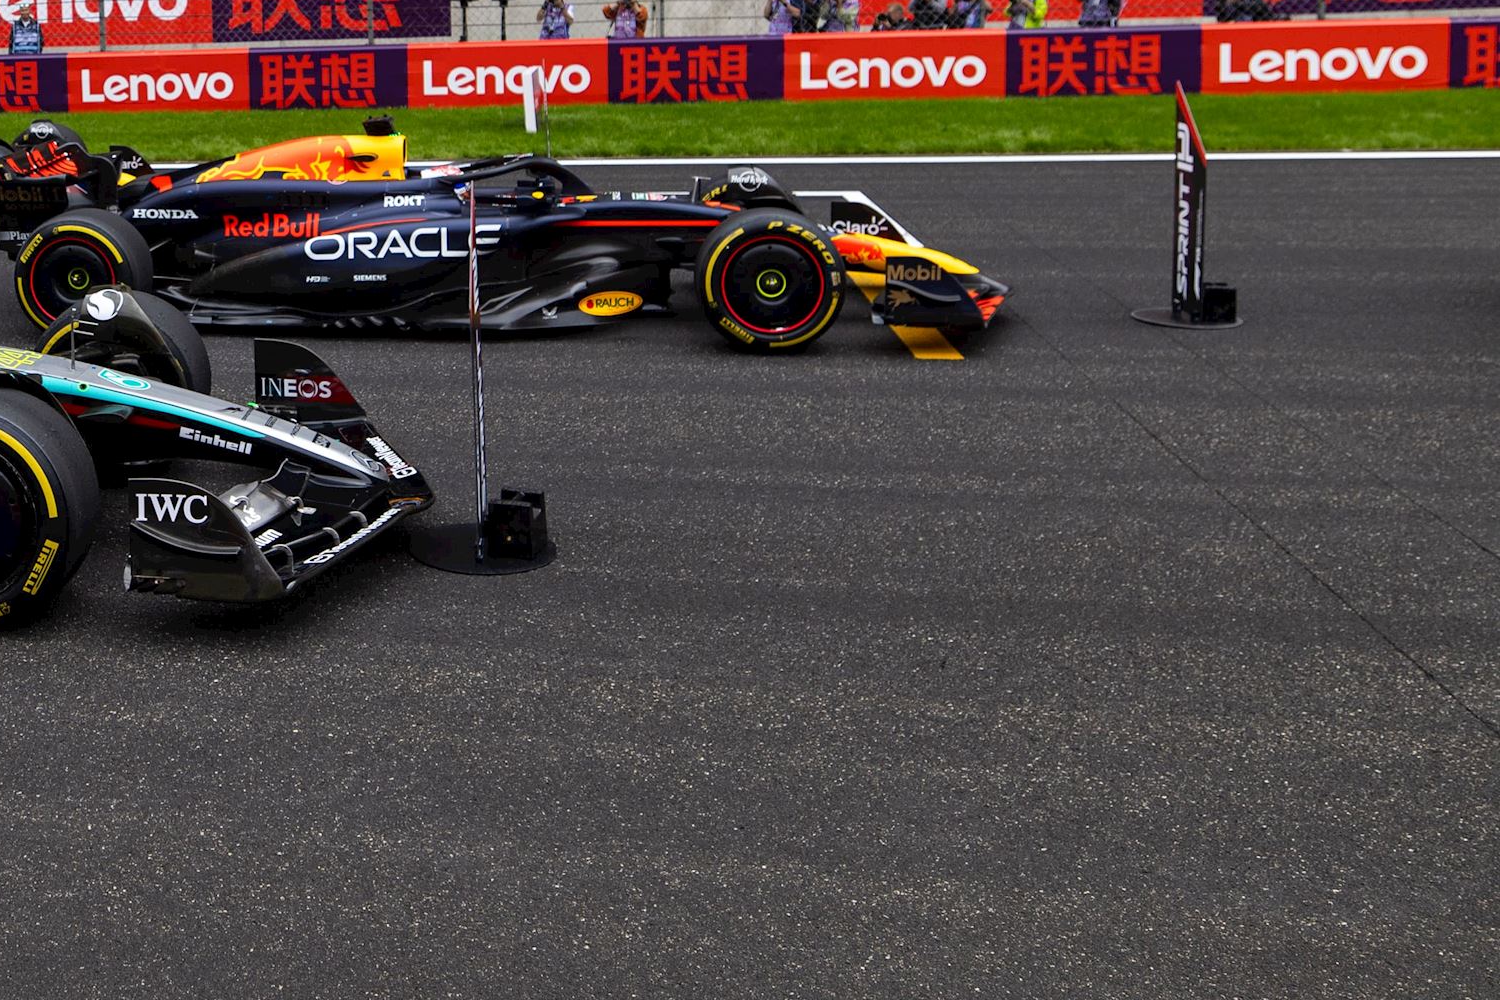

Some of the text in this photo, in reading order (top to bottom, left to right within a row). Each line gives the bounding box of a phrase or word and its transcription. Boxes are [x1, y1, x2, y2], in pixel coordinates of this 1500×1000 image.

[423, 60, 591, 96] Lenovo
[620, 44, 748, 102] 联想
[801, 51, 987, 90] Lenovo
[1019, 34, 1161, 97] 联想
[1219, 43, 1428, 83] Lenovo
[81, 69, 233, 102] Lenovo
[260, 52, 375, 108] 联想
[121, 158, 142, 169] aro
[132, 208, 199, 219] HONDA
[383, 195, 426, 208] ROKT
[223, 212, 321, 238] Red Bull
[832, 220, 880, 236] Claro
[1176, 172, 1191, 300] SPRINT
[304, 223, 502, 261] ORACLE
[768, 220, 836, 265] P ZERO
[353, 274, 387, 282] SIEMENS
[887, 265, 942, 281] Mobil
[595, 297, 635, 308] RAUCH
[261, 378, 332, 398] INEOS
[179, 427, 252, 455] Einhell
[135, 493, 208, 524] IWC
[22, 539, 60, 596] PIRELLI
